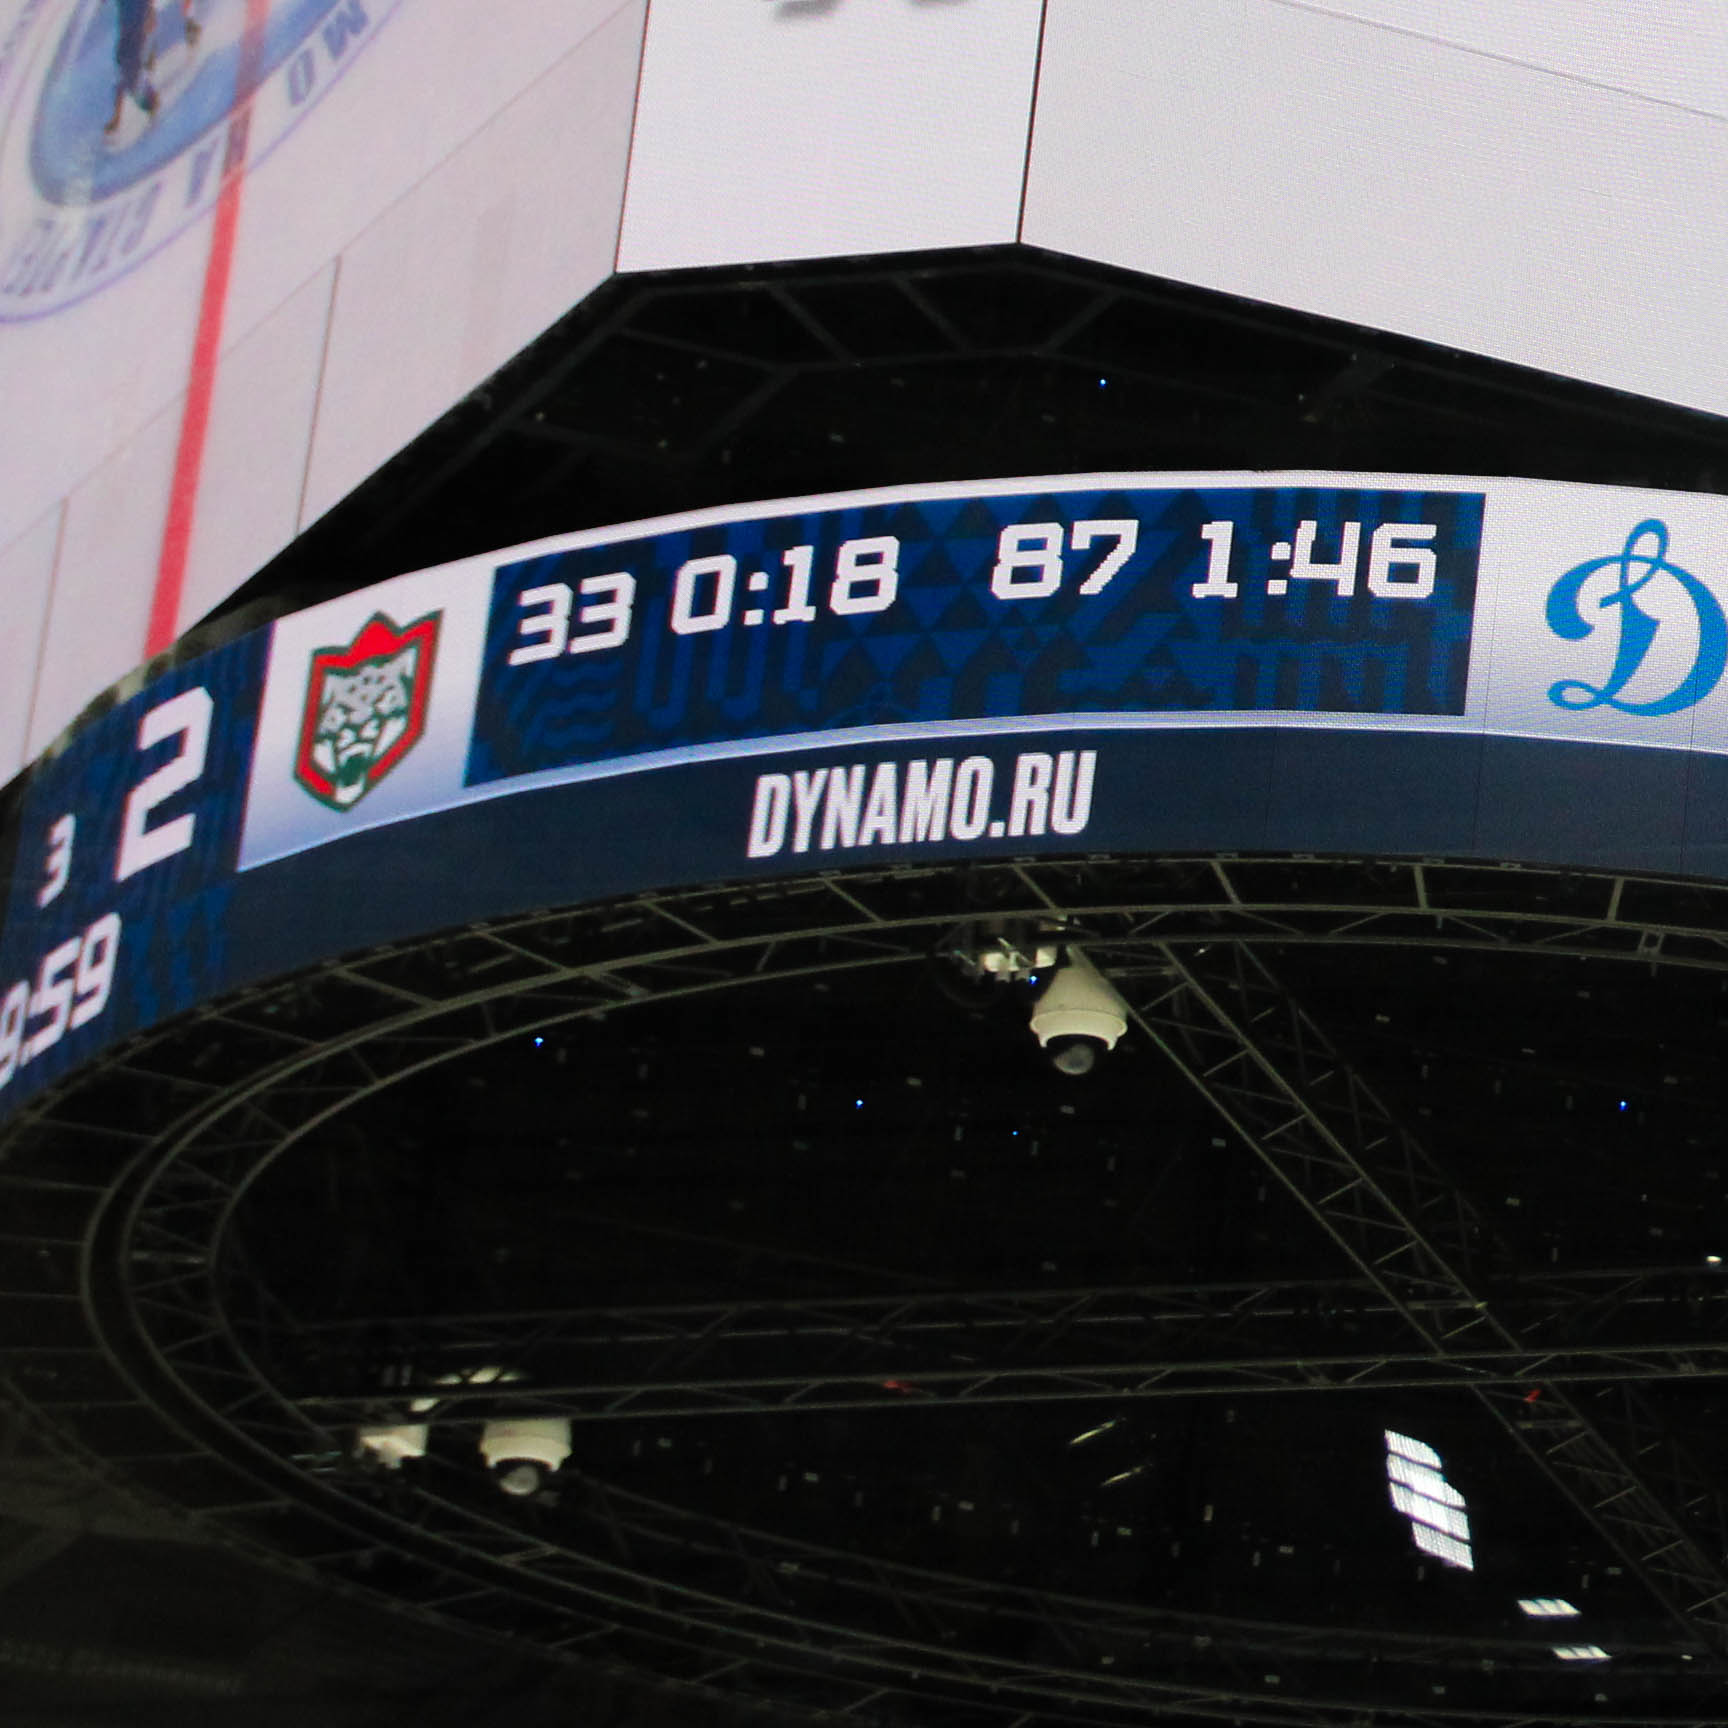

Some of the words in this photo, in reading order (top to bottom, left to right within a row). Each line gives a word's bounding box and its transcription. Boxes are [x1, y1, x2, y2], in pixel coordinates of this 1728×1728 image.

[508, 572, 635, 666] 33
[672, 536, 900, 635] 0:18
[991, 520, 1138, 600] 87
[1191, 521, 1437, 599] 1:46
[115, 685, 214, 883] 2
[748, 751, 1096, 858] DYNAMO.RU
[0, 912, 122, 1090] 9:59
